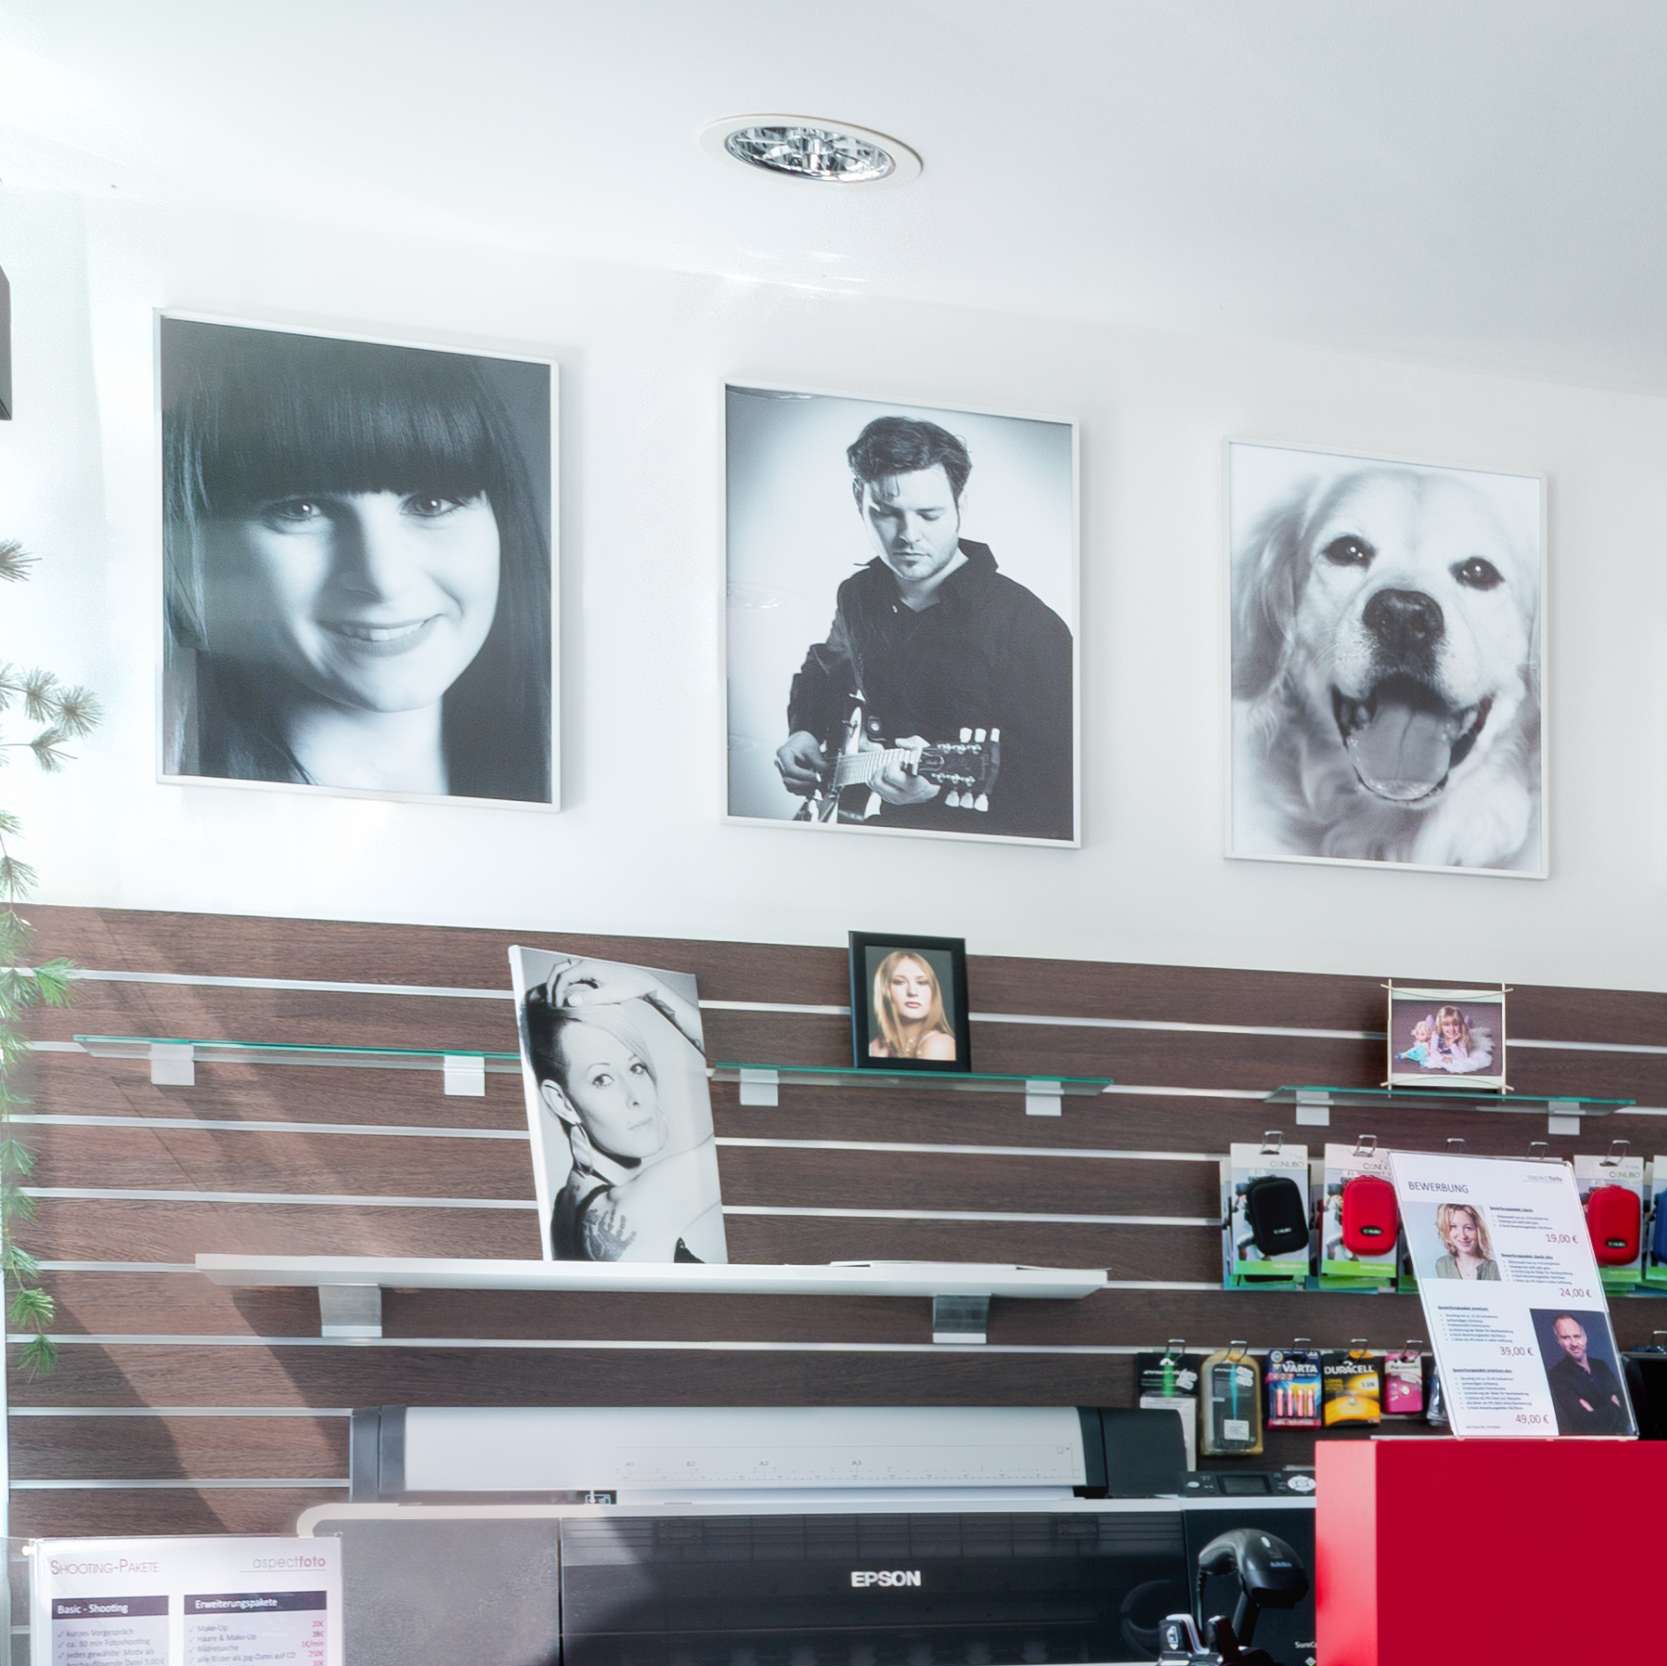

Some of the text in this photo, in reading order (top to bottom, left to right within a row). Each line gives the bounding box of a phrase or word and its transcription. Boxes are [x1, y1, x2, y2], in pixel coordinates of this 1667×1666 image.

[1408, 1181, 1470, 1194] BEWERBUNG
[1546, 1234, 1570, 1244] 19,00
[1560, 1288, 1584, 1298] 24,00
[1500, 1346, 1525, 1357] 39,00
[1282, 1361, 1318, 1373] VARTA
[1324, 1364, 1374, 1375] DURACELL
[1515, 1414, 1541, 1425] 49,00
[252, 1556, 327, 1571] aspectfoto
[851, 1570, 921, 1587] EPSON
[57, 1604, 80, 1615] Basic
[88, 1602, 129, 1616] Shooting
[195, 1598, 278, 1611] Erweiterungspakete
